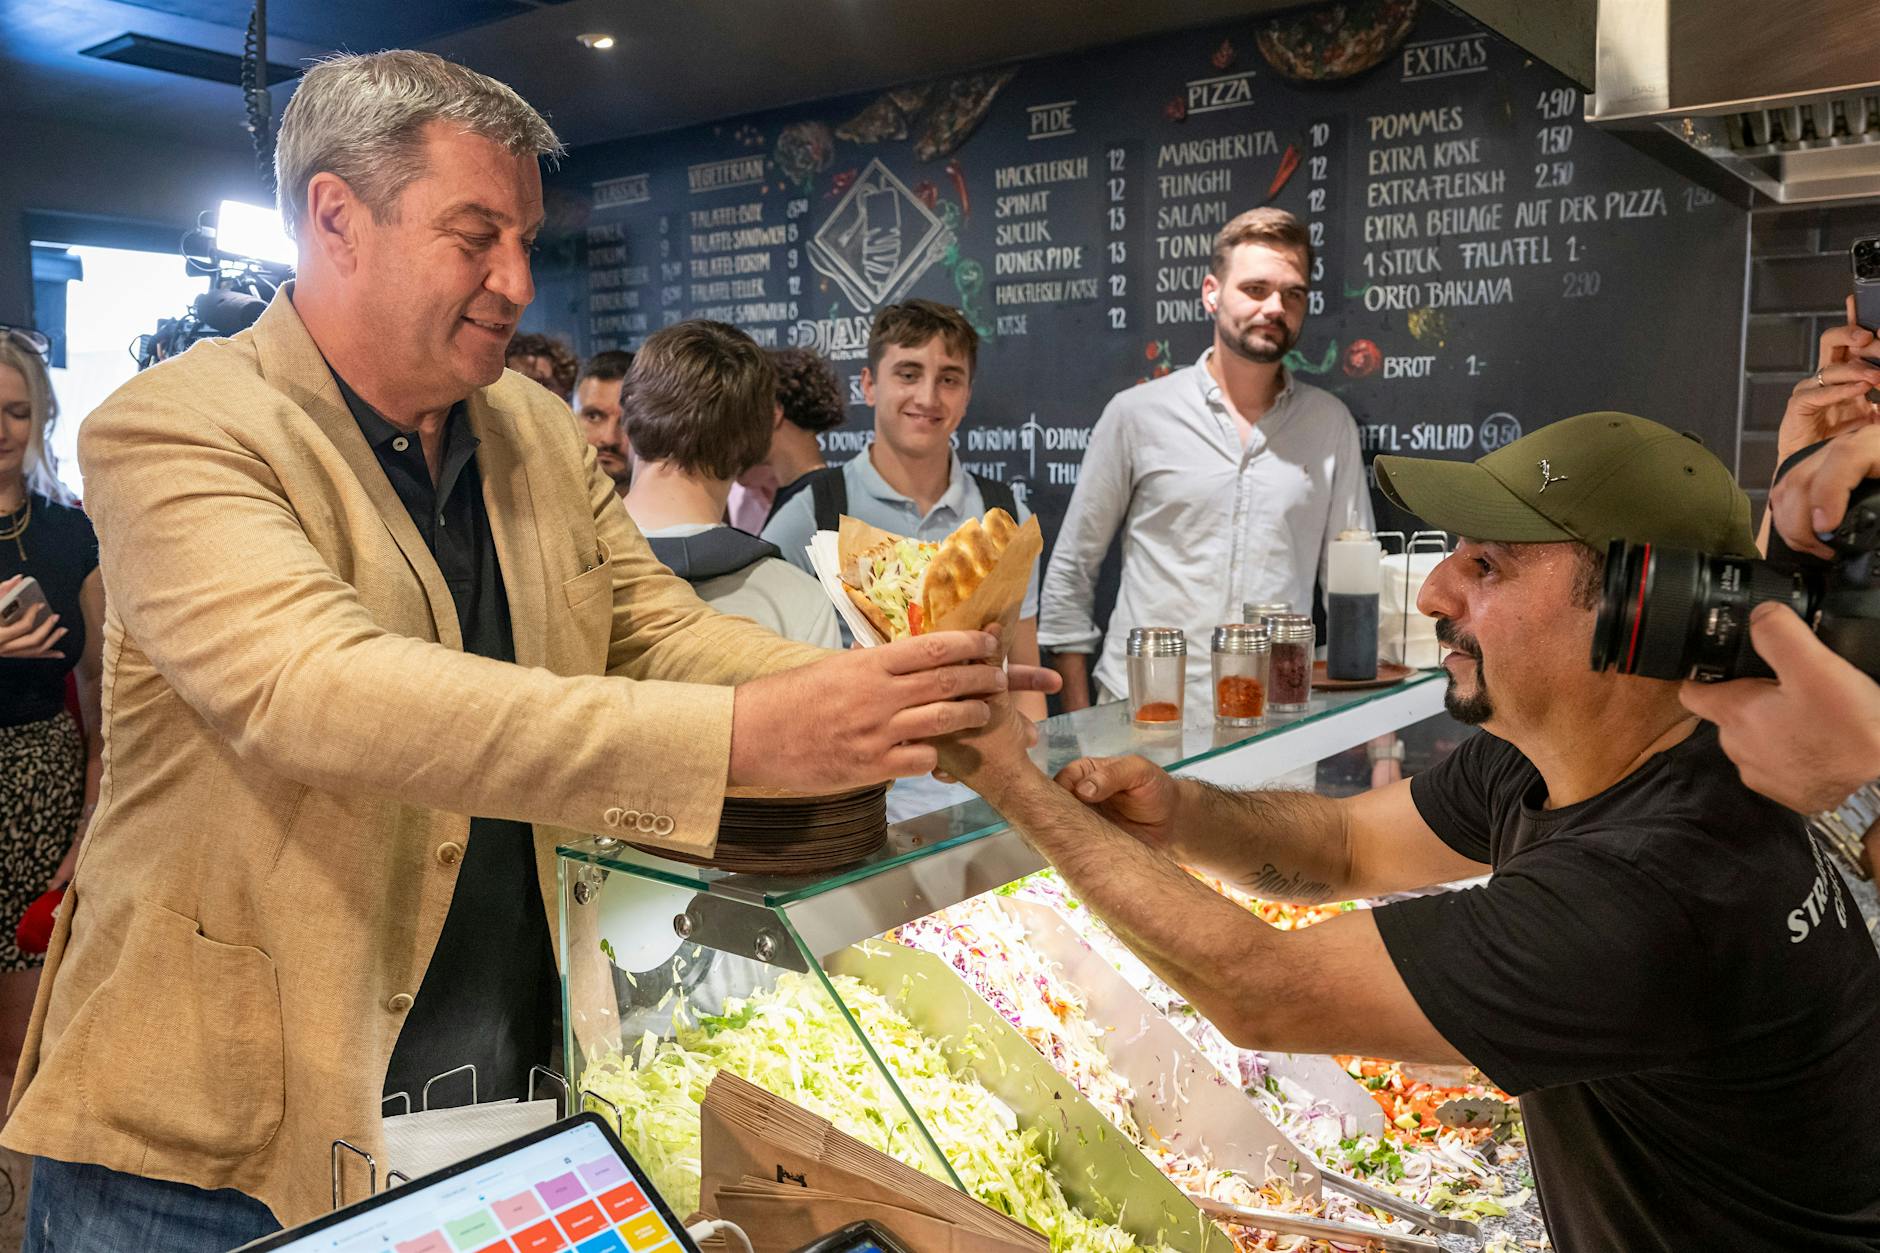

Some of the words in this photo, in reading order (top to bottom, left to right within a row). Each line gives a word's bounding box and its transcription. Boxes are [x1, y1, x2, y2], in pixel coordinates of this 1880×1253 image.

[1403, 39, 1487, 76] EXTRAS
[1187, 79, 1252, 108] PIZZA
[1031, 107, 1072, 133] PIDE
[1369, 106, 1465, 141] POMMES
[1157, 131, 1279, 168] MARGHERITA
[1309, 123, 1330, 148] 10
[1368, 145, 1428, 176] EXTRA
[995, 157, 1089, 189] HACKFLEISCH
[1107, 148, 1126, 172] 12
[1157, 169, 1231, 199] FUNGHI
[1308, 156, 1328, 181] 12
[995, 191, 1051, 218] SPINAT
[1107, 178, 1126, 201] 12
[1157, 201, 1228, 230] SALAMI
[1307, 188, 1327, 213] 12
[1365, 212, 1419, 243] EXTRA
[1426, 204, 1503, 236] BEILAGE
[1515, 199, 1553, 229] AUF
[1559, 194, 1599, 224] DER
[1605, 188, 1668, 221] PIZZA
[996, 220, 1052, 246] SUCUK
[1156, 233, 1218, 260] TONN
[1308, 221, 1325, 247] 12
[787, 249, 798, 269] 9
[1046, 246, 1083, 271] PIDE
[1363, 252, 1375, 278] 1
[1458, 236, 1552, 269] FALAFEL
[1108, 275, 1127, 297] 12
[1156, 265, 1211, 293] SUCU
[1312, 257, 1325, 282] 3
[788, 301, 799, 321] 8
[1364, 284, 1421, 312] OREO
[1424, 277, 1514, 309] BAKLAVA
[1107, 307, 1128, 329] 12
[1156, 298, 1216, 325] DONE
[786, 326, 798, 347] 9
[1383, 355, 1437, 379] BROT
